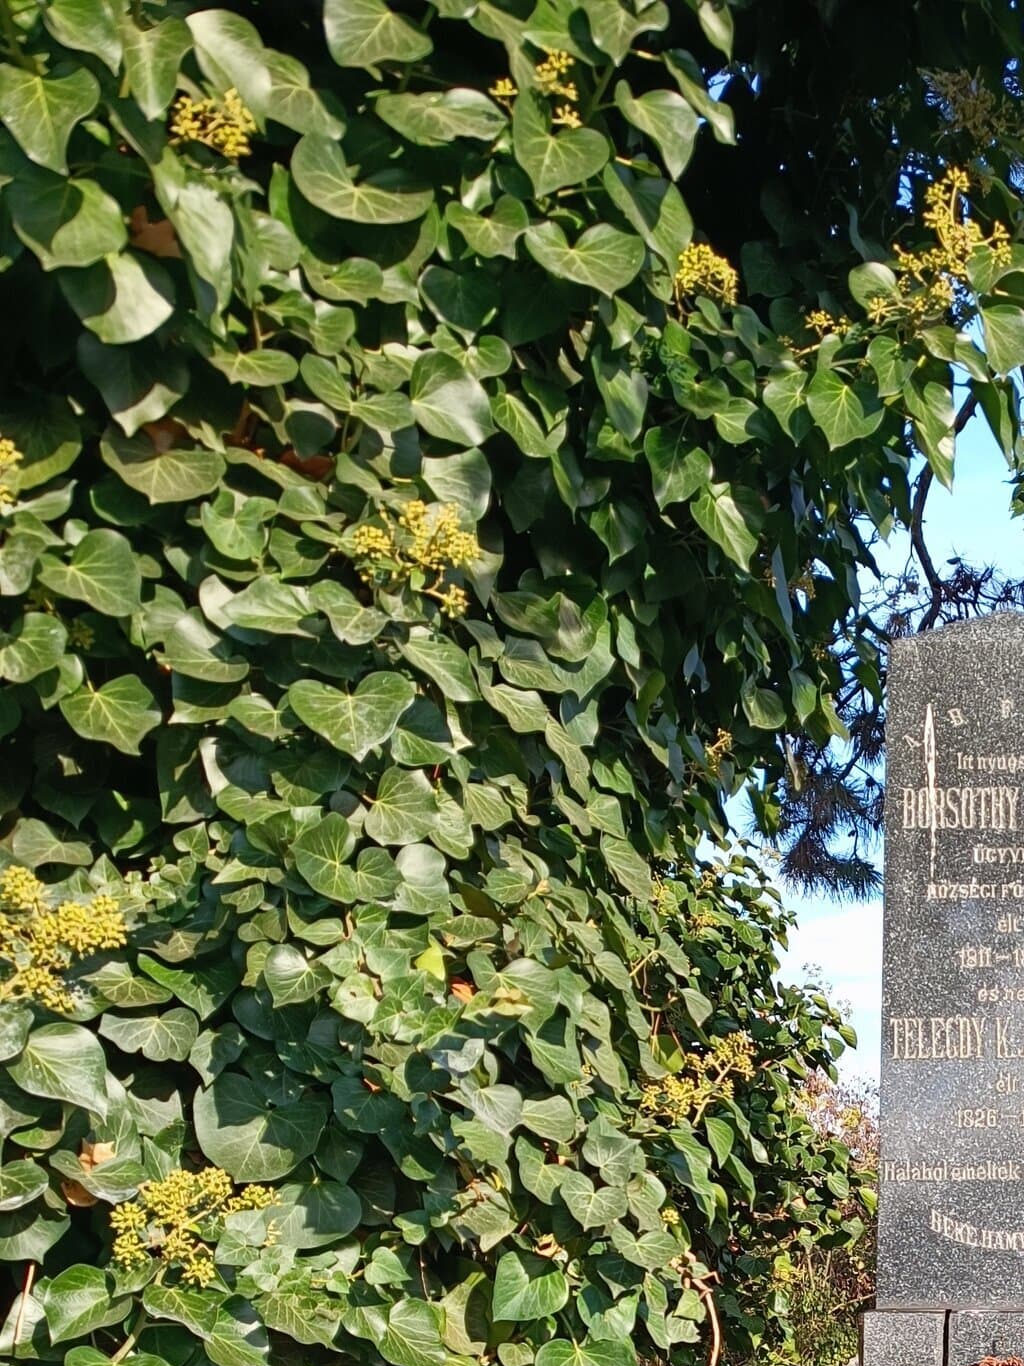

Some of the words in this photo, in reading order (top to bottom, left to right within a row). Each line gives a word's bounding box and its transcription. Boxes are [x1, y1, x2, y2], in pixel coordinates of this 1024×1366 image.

[948, 708, 966, 727] B
[902, 786, 1019, 829] BORSOTHY
[890, 1016, 985, 1059] TELEGDY
